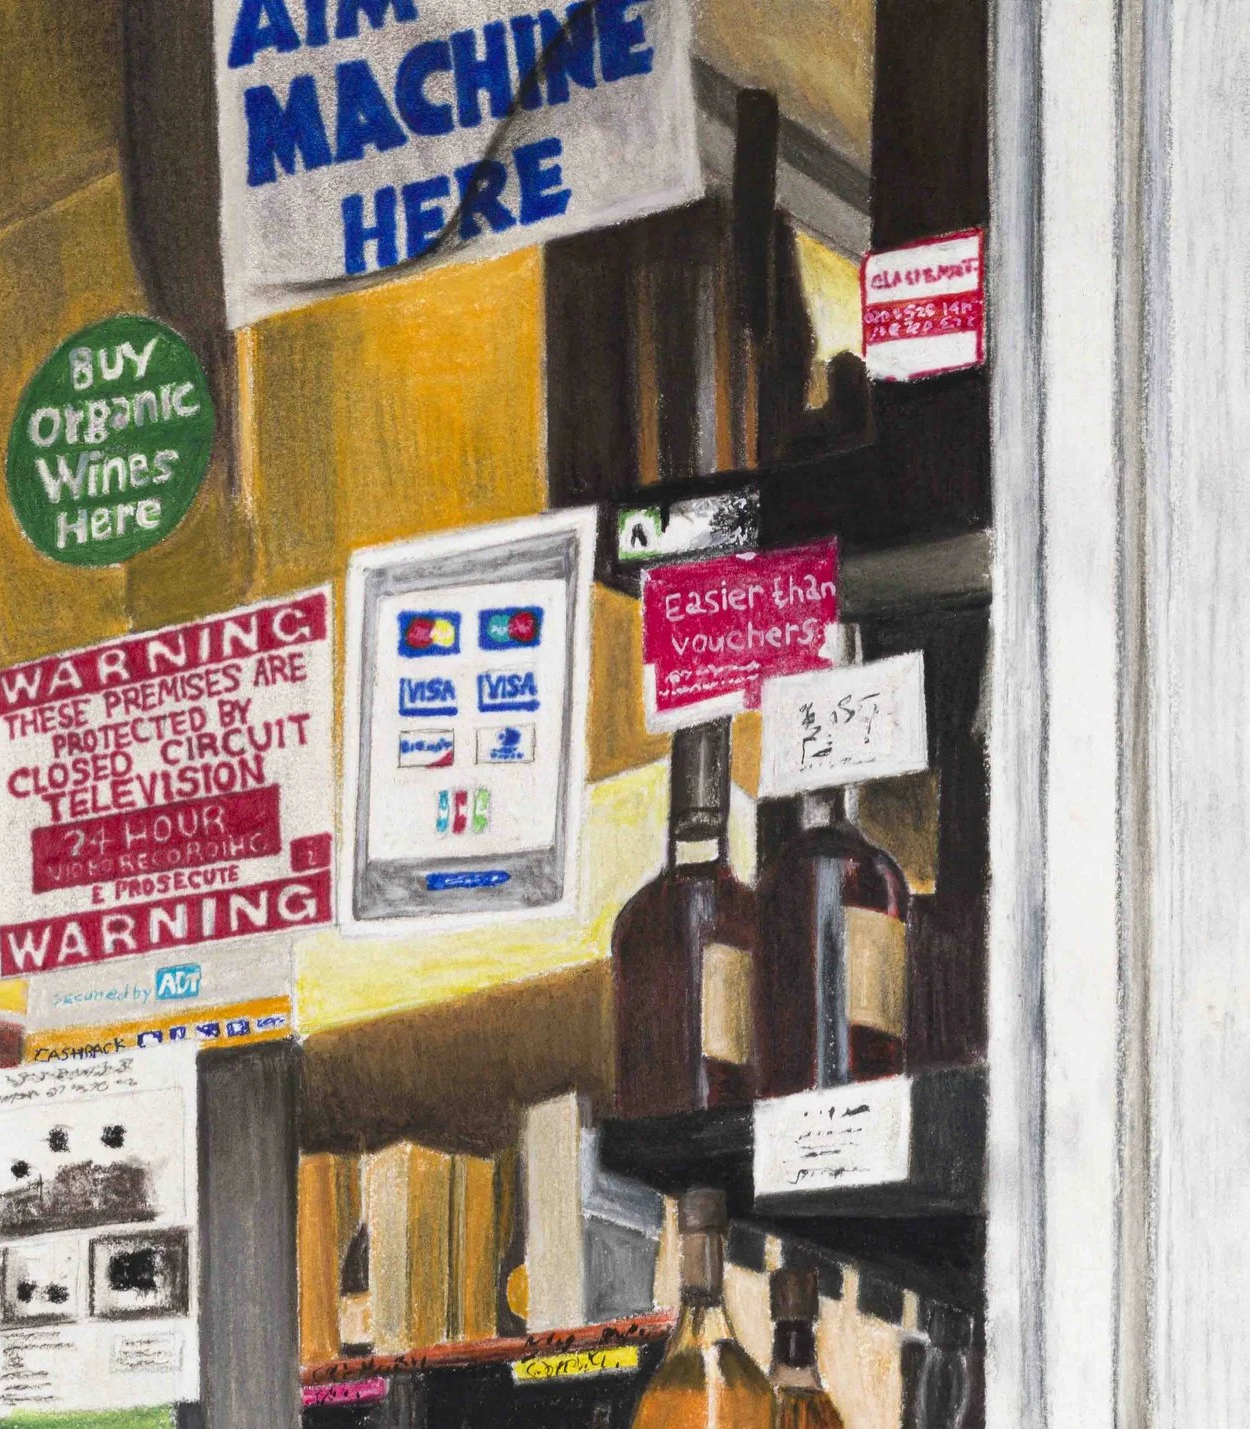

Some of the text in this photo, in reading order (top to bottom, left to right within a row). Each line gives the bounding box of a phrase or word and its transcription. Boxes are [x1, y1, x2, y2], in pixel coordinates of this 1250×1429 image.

[243, 0, 655, 187] MACHINE
[342, 137, 573, 275] HERE
[34, 449, 180, 504] Wines
[56, 498, 162, 549] Here
[664, 574, 837, 622] Easier than
[0, 607, 312, 704] WARNING
[485, 671, 538, 700] VISA
[2, 652, 308, 740] THESE PREMISES ARE
[7, 713, 312, 800] CLOSED CIRCUIT
[52, 697, 253, 759] PROTECTED BY
[41, 754, 266, 824] TELEVISION
[125, 804, 226, 849] HOUR
[115, 864, 240, 900] PROSECUTE
[7, 884, 318, 970] WARNING
[158, 971, 201, 996] ADT
